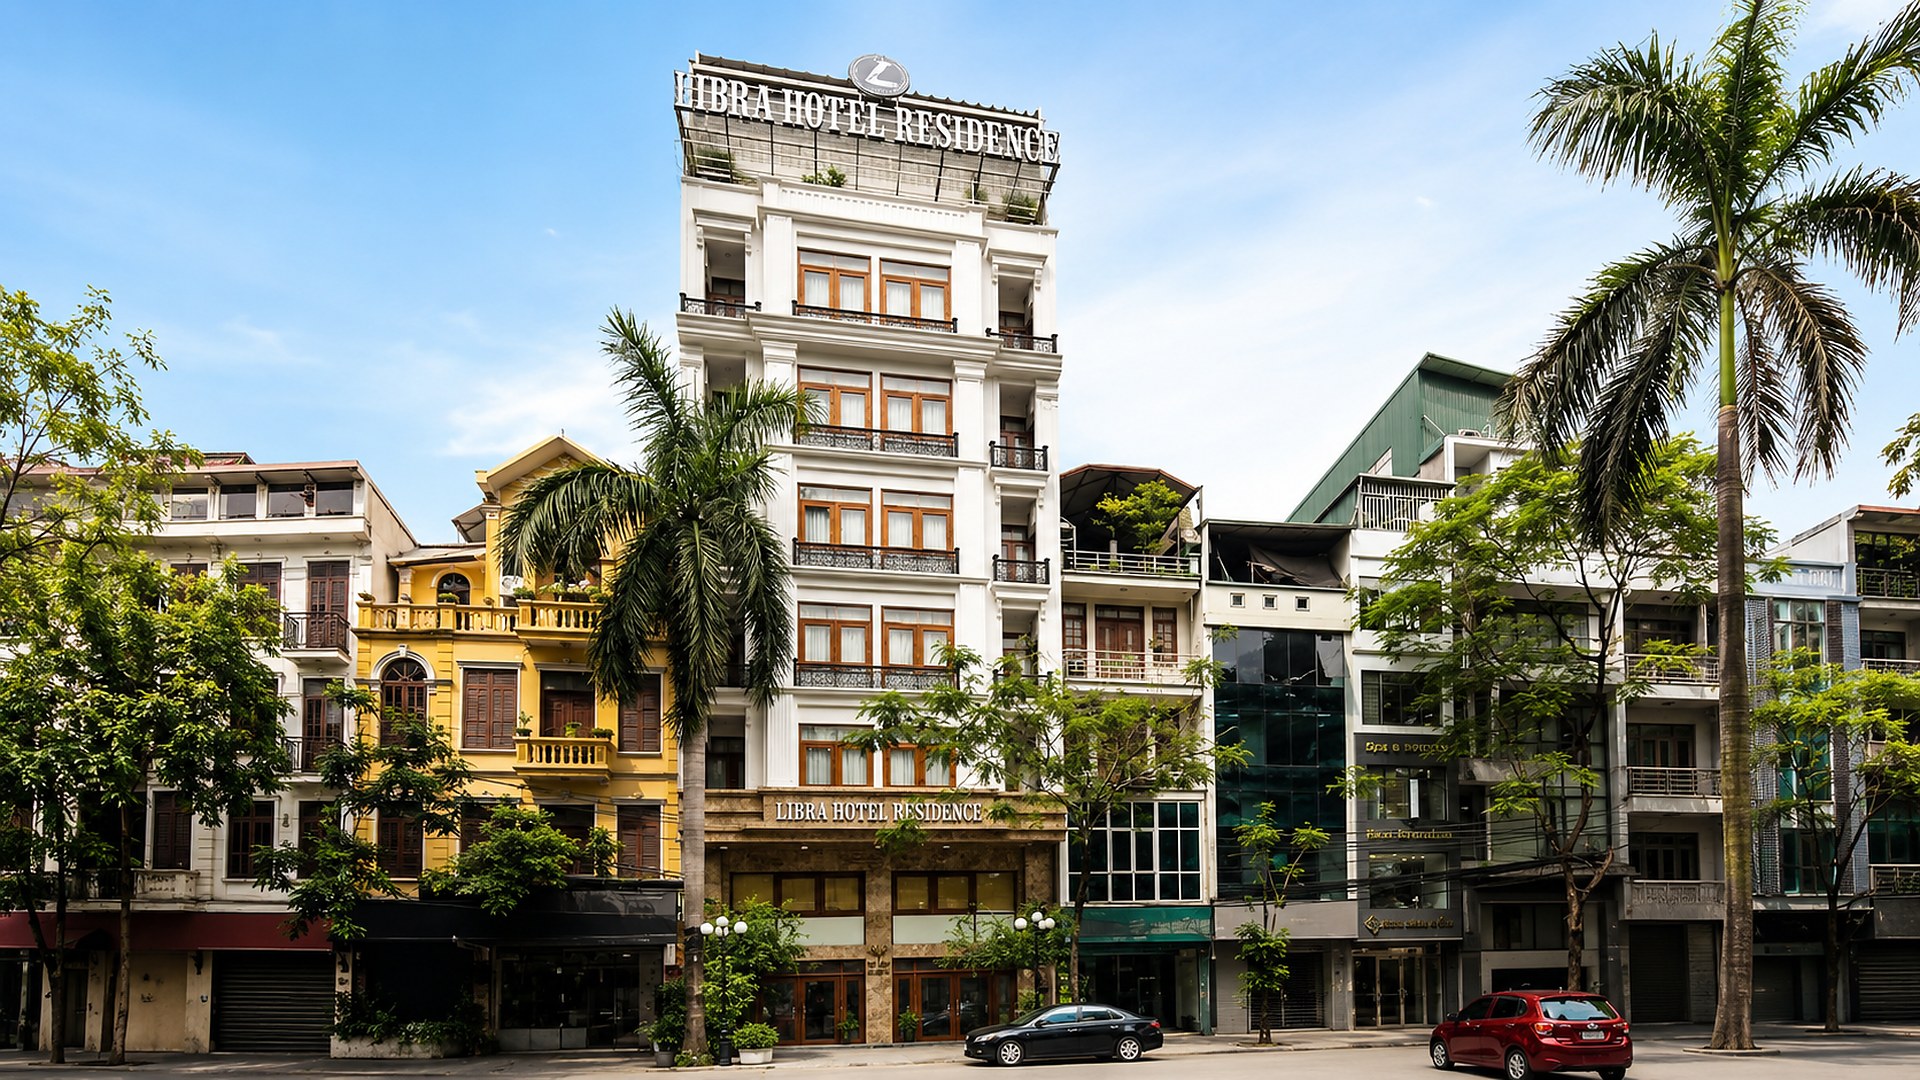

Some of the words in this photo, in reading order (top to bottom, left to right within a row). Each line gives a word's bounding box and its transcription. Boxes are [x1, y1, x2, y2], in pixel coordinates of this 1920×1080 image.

[675, 70, 774, 122] LIBRA
[782, 88, 886, 139] HOTEL
[894, 106, 1060, 163] RESIDENCE
[775, 802, 827, 821] LIBRA
[832, 802, 888, 821] HOTEL
[893, 802, 982, 821] RESIDENCE
